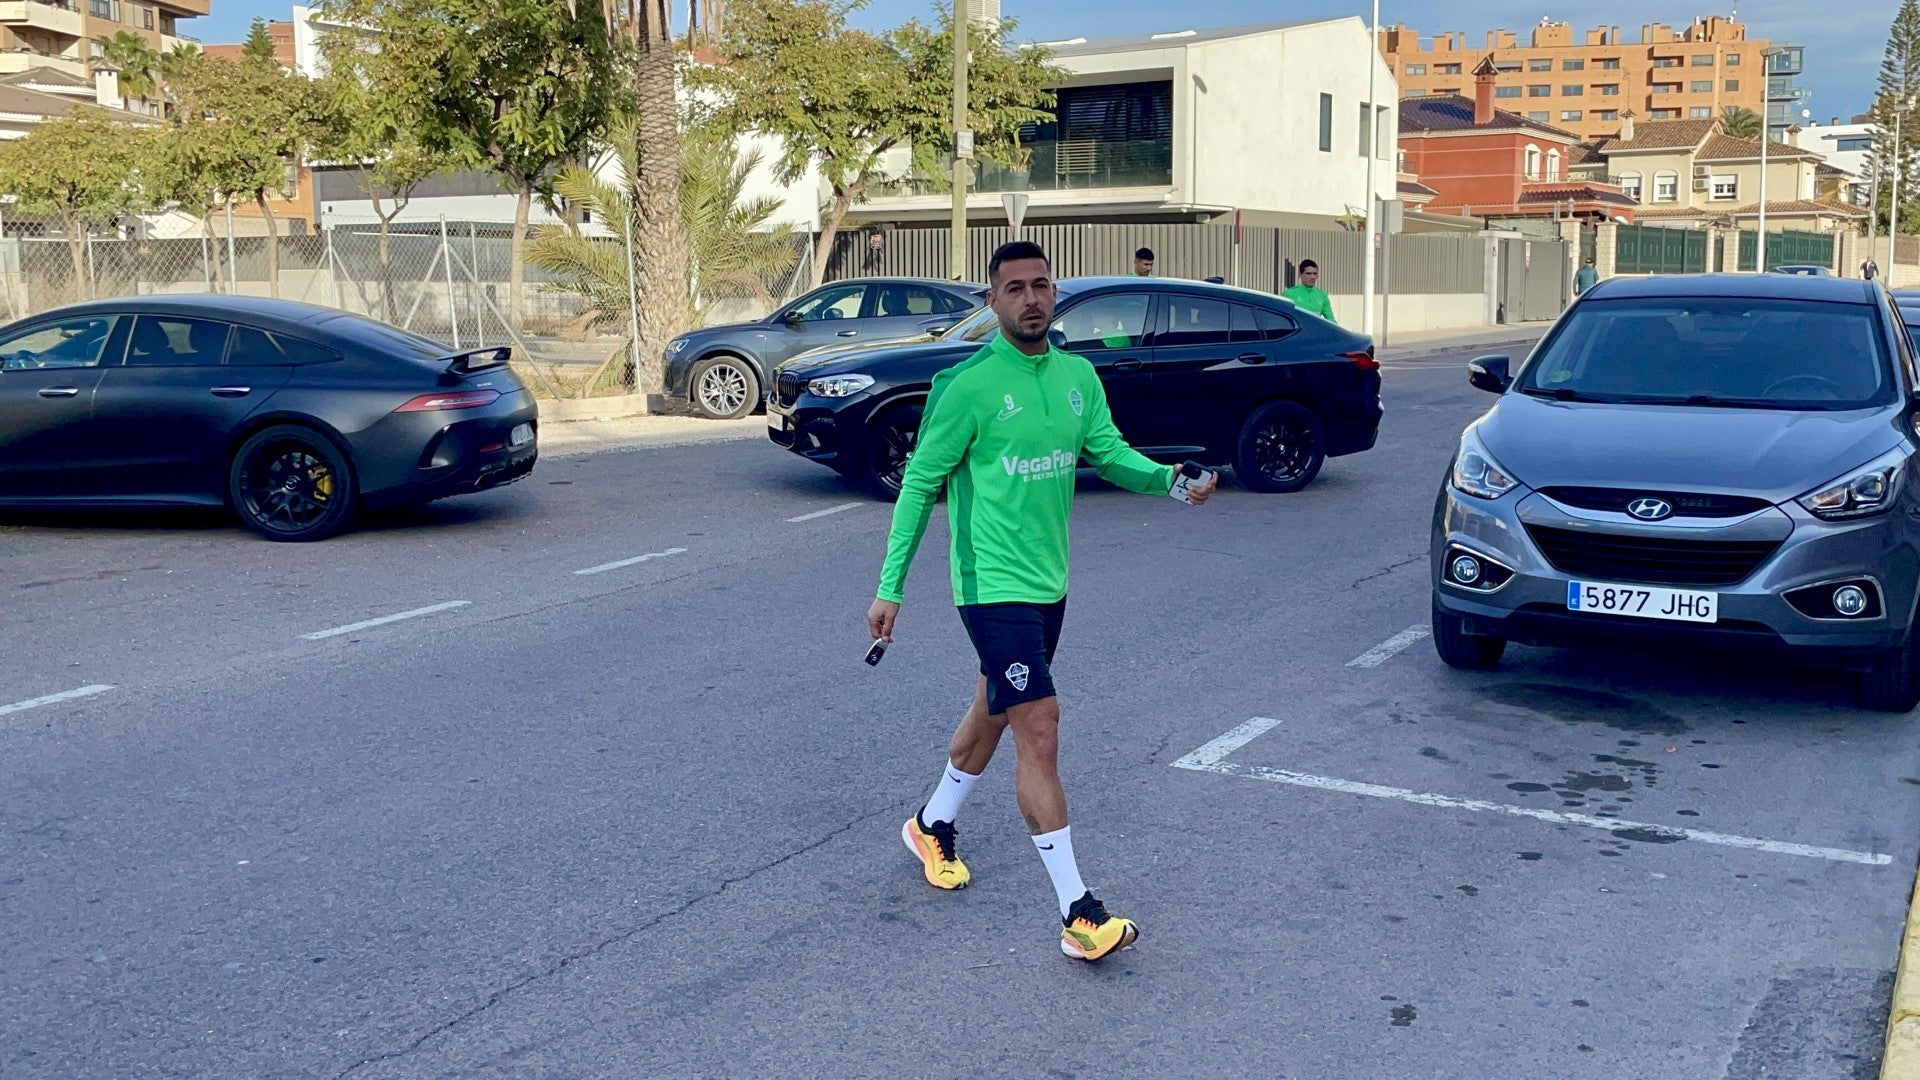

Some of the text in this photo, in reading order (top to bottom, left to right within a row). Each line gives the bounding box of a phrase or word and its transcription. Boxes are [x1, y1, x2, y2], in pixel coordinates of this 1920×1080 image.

[1004, 394, 1014, 410] 9
[1586, 586, 1710, 618] 5877 JHG
